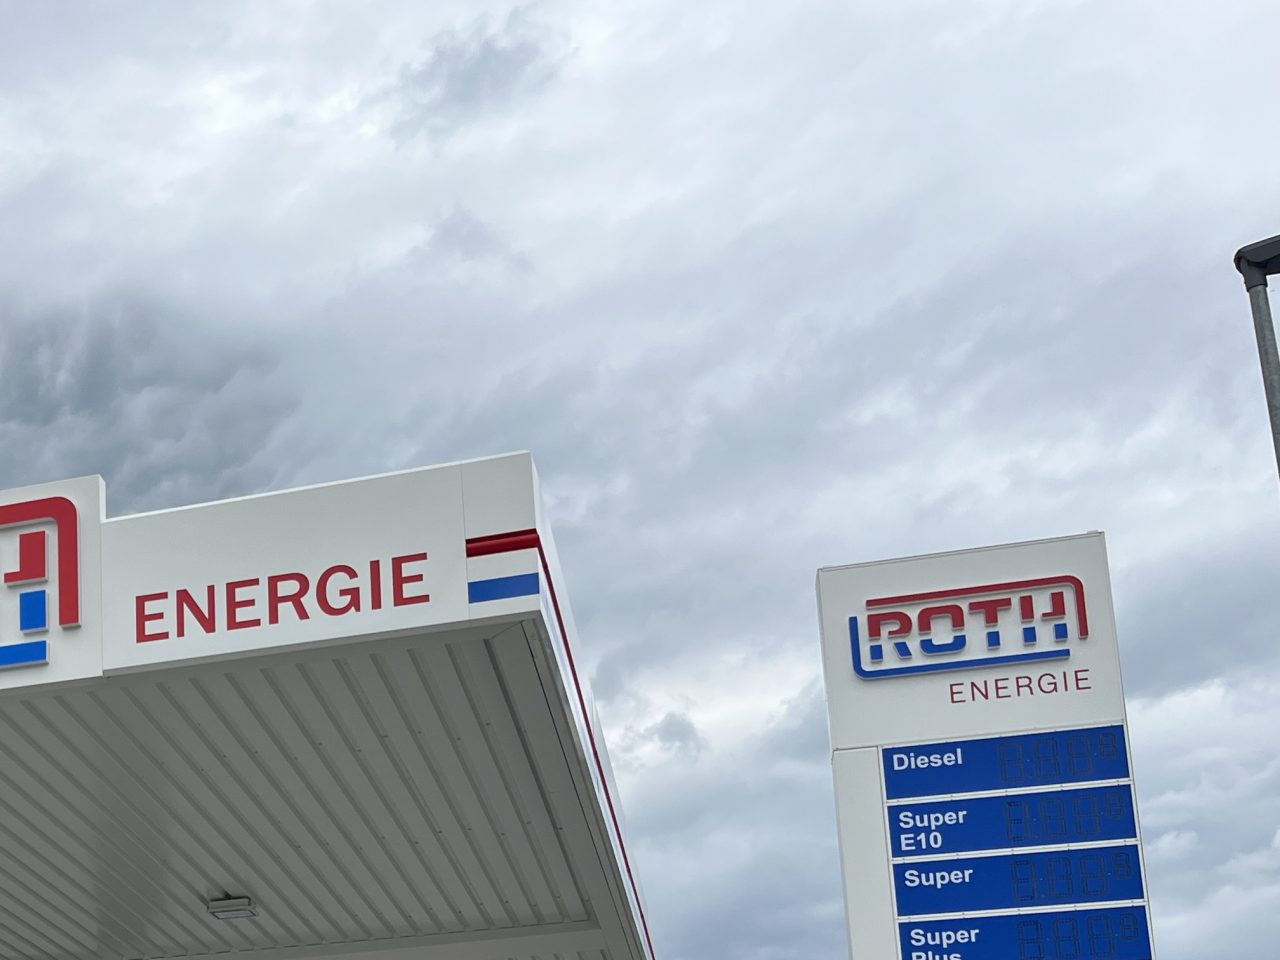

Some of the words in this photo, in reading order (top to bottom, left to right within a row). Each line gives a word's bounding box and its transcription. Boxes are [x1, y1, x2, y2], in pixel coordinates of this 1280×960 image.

[135, 552, 430, 643] ENERGIE
[867, 591, 1068, 663] ROTH
[949, 669, 1092, 703] ENERGIE
[892, 748, 963, 771] Diesel
[898, 809, 967, 830] Super
[900, 831, 943, 851] E10
[904, 867, 974, 889] Super
[910, 927, 980, 949] Super
